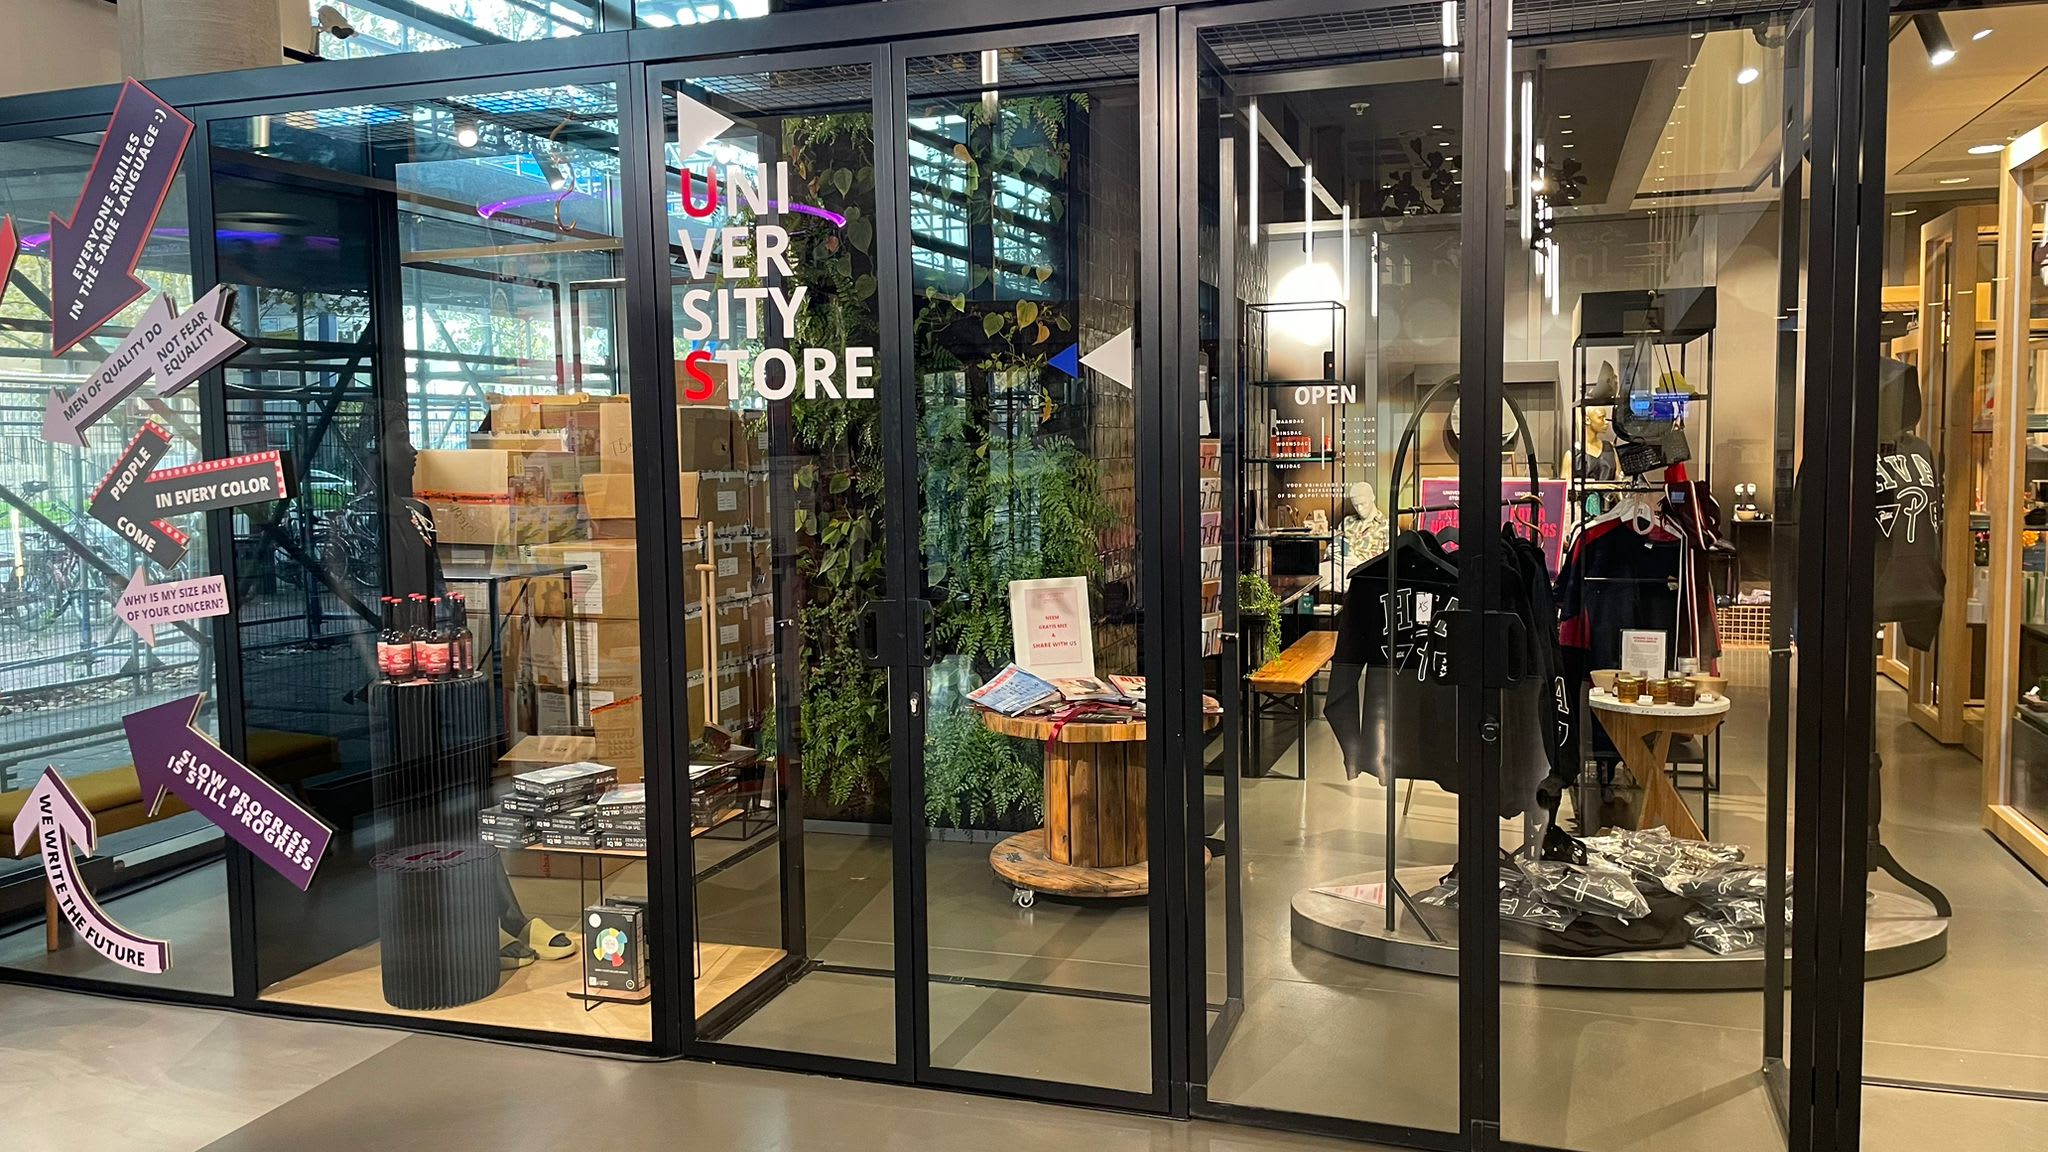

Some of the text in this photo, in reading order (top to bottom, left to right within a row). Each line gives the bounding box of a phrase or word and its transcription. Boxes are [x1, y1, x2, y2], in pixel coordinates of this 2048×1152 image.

[73, 132, 141, 281] EVERYONE SMILES
[681, 161, 789, 218] UNI
[69, 300, 84, 320] IN
[78, 269, 99, 298] THE
[94, 218, 120, 265] SAME
[115, 124, 159, 216] LANGUAGE
[678, 225, 794, 280] VER
[156, 311, 208, 363] NOT FEAR
[682, 286, 808, 341] SITY
[63, 322, 163, 422] MEN OF QUALITY DO
[164, 325, 216, 377] EQUALITY
[684, 347, 875, 401] STORE
[1294, 385, 1357, 405] OPEN
[110, 446, 151, 501] PEOPLE
[155, 476, 271, 509] IN EVERY COLOR
[116, 516, 156, 553] COME
[124, 582, 222, 607] WHY IS MY SIZE ANY
[127, 599, 224, 621] OF YOUR CONCERN?
[167, 755, 314, 871] IS STILL PROGRESS
[180, 750, 311, 854] SLOW PROGRESS
[39, 794, 145, 967] WE WRITE THE FUTURE
